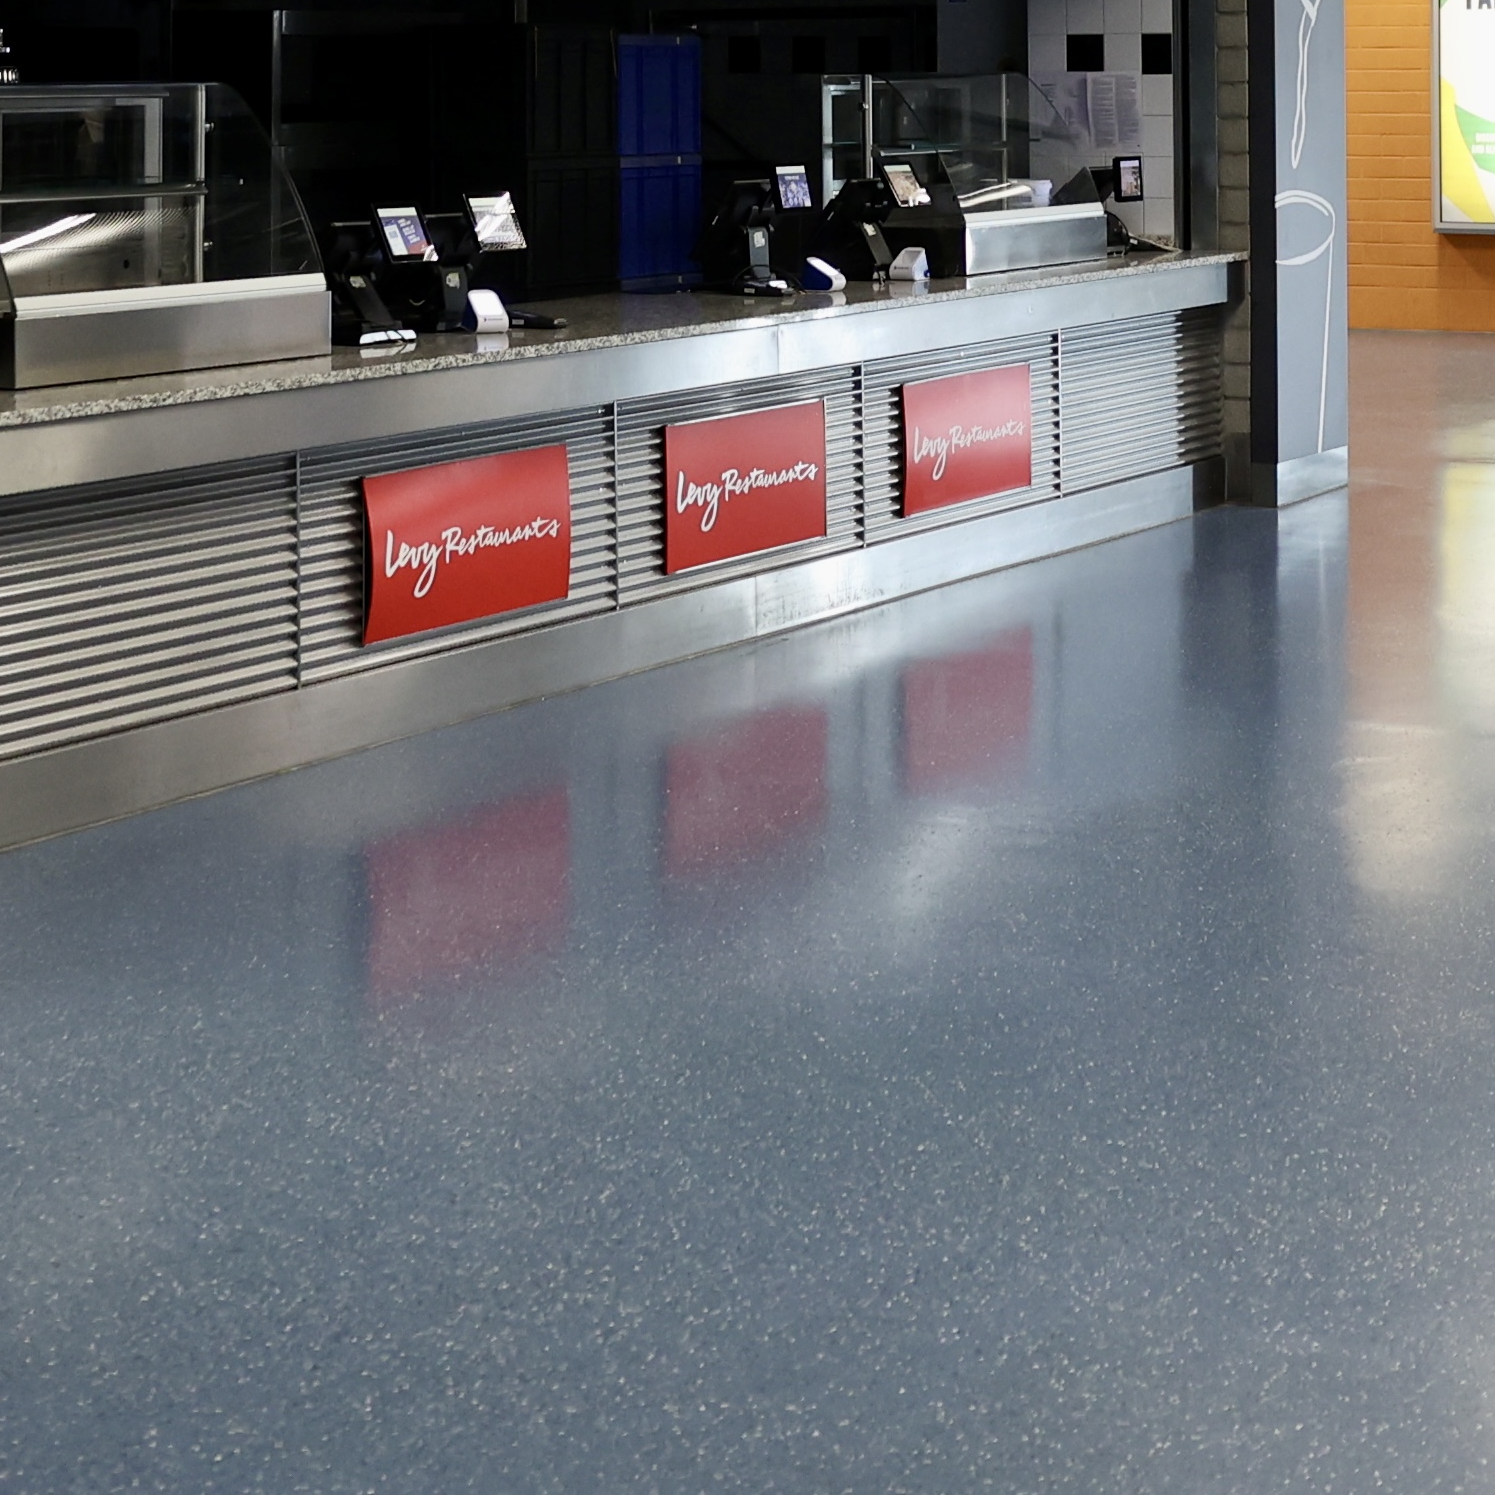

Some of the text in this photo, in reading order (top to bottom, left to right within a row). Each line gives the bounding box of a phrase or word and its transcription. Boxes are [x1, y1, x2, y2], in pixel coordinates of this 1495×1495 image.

[913, 418, 1025, 481] Levy Restaurants
[677, 460, 818, 532] Levy Restaurants
[385, 516, 561, 598] Levy Restaurants
